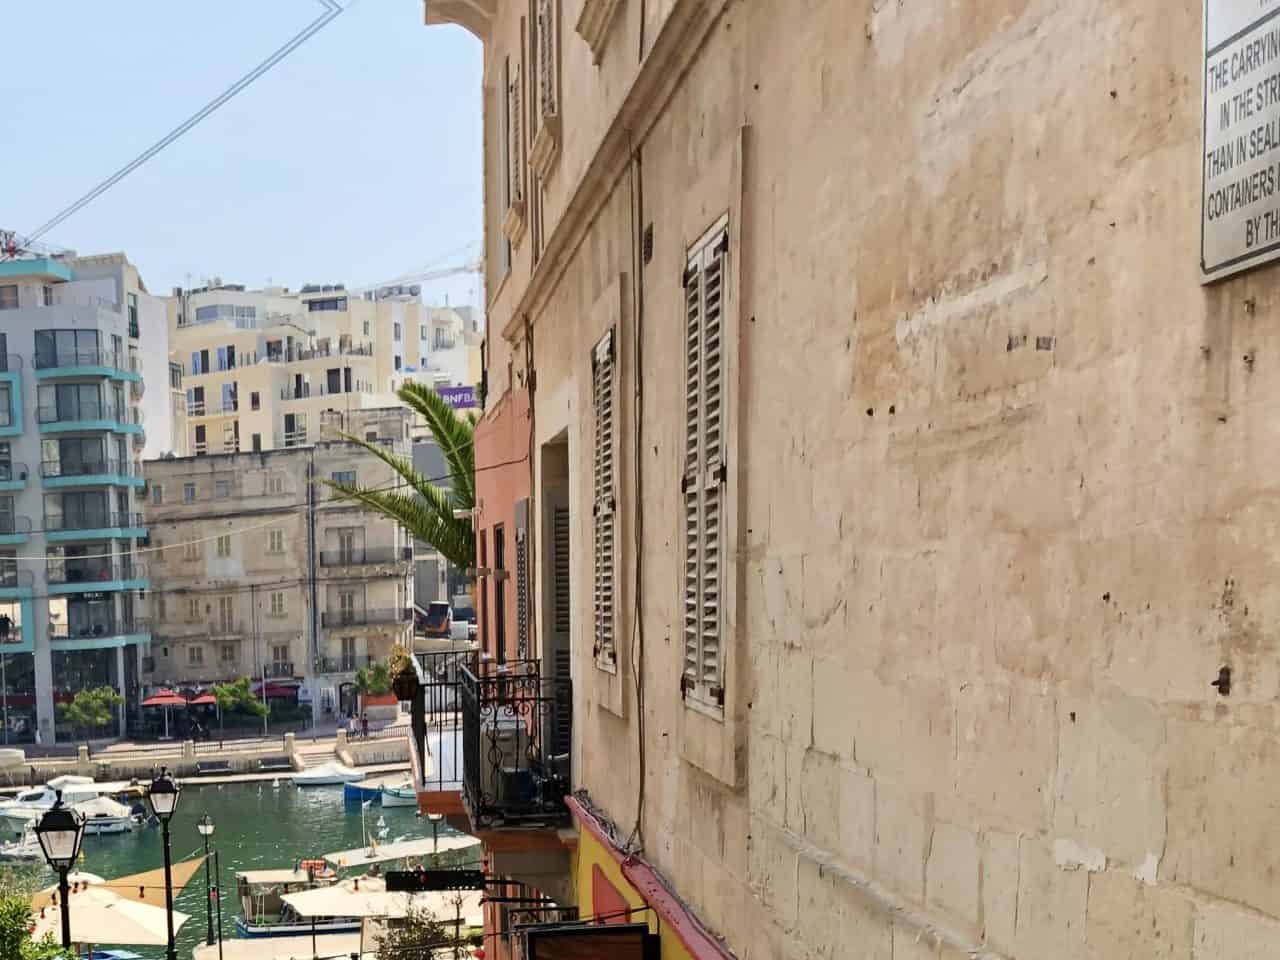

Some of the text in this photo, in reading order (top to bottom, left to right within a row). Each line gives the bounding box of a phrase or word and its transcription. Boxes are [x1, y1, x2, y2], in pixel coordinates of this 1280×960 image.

[1209, 27, 1280, 94] THE CARRYIN
[1220, 99, 1230, 131] IN
[1232, 87, 1253, 124] THE
[1207, 121, 1280, 180] THAN IN SEAL
[1207, 165, 1274, 221] CONTAINERS
[1245, 208, 1280, 249] BY TH
